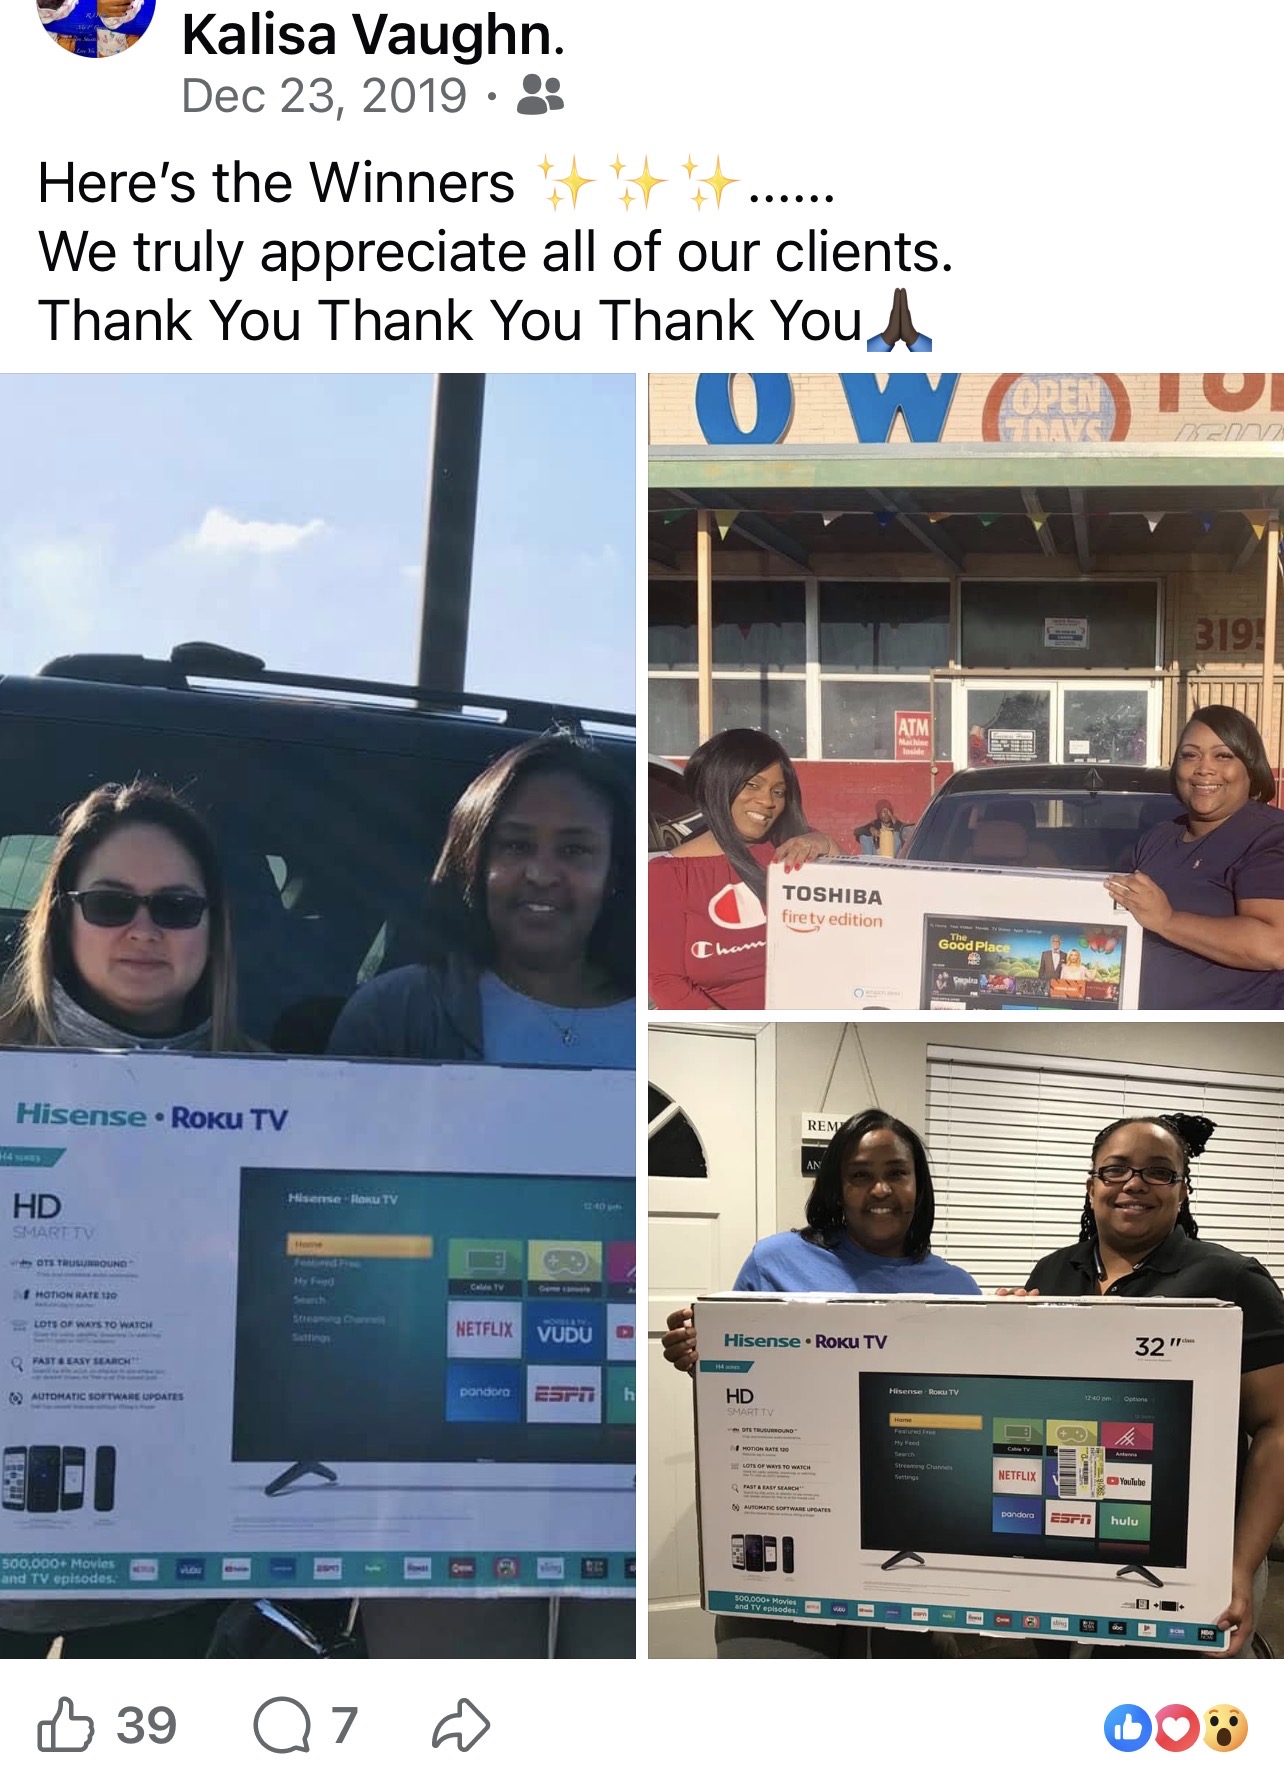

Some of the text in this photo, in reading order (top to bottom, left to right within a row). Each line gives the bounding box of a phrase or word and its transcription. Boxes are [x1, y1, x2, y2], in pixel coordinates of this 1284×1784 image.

[1012, 379, 1100, 415] OPEN
[898, 718, 929, 736] ATM
[899, 739, 929, 747] Machine
[782, 885, 882, 905] TOSHIBA
[829, 912, 883, 927] edition
[950, 933, 967, 941] The
[939, 939, 1010, 953] Good Place
[16, 1102, 147, 1128] Hisense
[250, 1108, 289, 1131] TV
[808, 1120, 844, 1132] REM
[288, 1193, 341, 1203] Hisense
[383, 1195, 399, 1205] TV
[14, 1193, 61, 1219] HD
[13, 1225, 70, 1240] SMART
[35, 1291, 73, 1300] MOTION
[101, 1292, 117, 1300] 120
[34, 1320, 152, 1329] LOTS OF WAYS TO WATCH
[293, 1315, 341, 1324] Streaming
[456, 1321, 513, 1338] NETFLIX
[537, 1327, 592, 1343] VUDU
[724, 1333, 888, 1349] Hisense Roku TV
[67, 1358, 91, 1366] EASY
[31, 1393, 183, 1401] AUTOMATIC SOFTWARE UPDATES
[460, 1387, 510, 1398] pandora
[535, 1386, 595, 1402] ESPN
[726, 1389, 754, 1404] HD
[727, 1408, 774, 1416] SMART TV
[999, 1470, 1036, 1482] NETFLIX
[1120, 1477, 1145, 1486] YouTube
[1002, 1511, 1034, 1519] pandora
[1050, 1513, 1091, 1525] ESPN
[1111, 1516, 1139, 1526] hulu
[2, 1558, 115, 1570] 500,000+ Movies
[2, 1573, 26, 1585] and
[30, 1574, 49, 1585] TV
[735, 1595, 797, 1606] 500,000+ Movies
